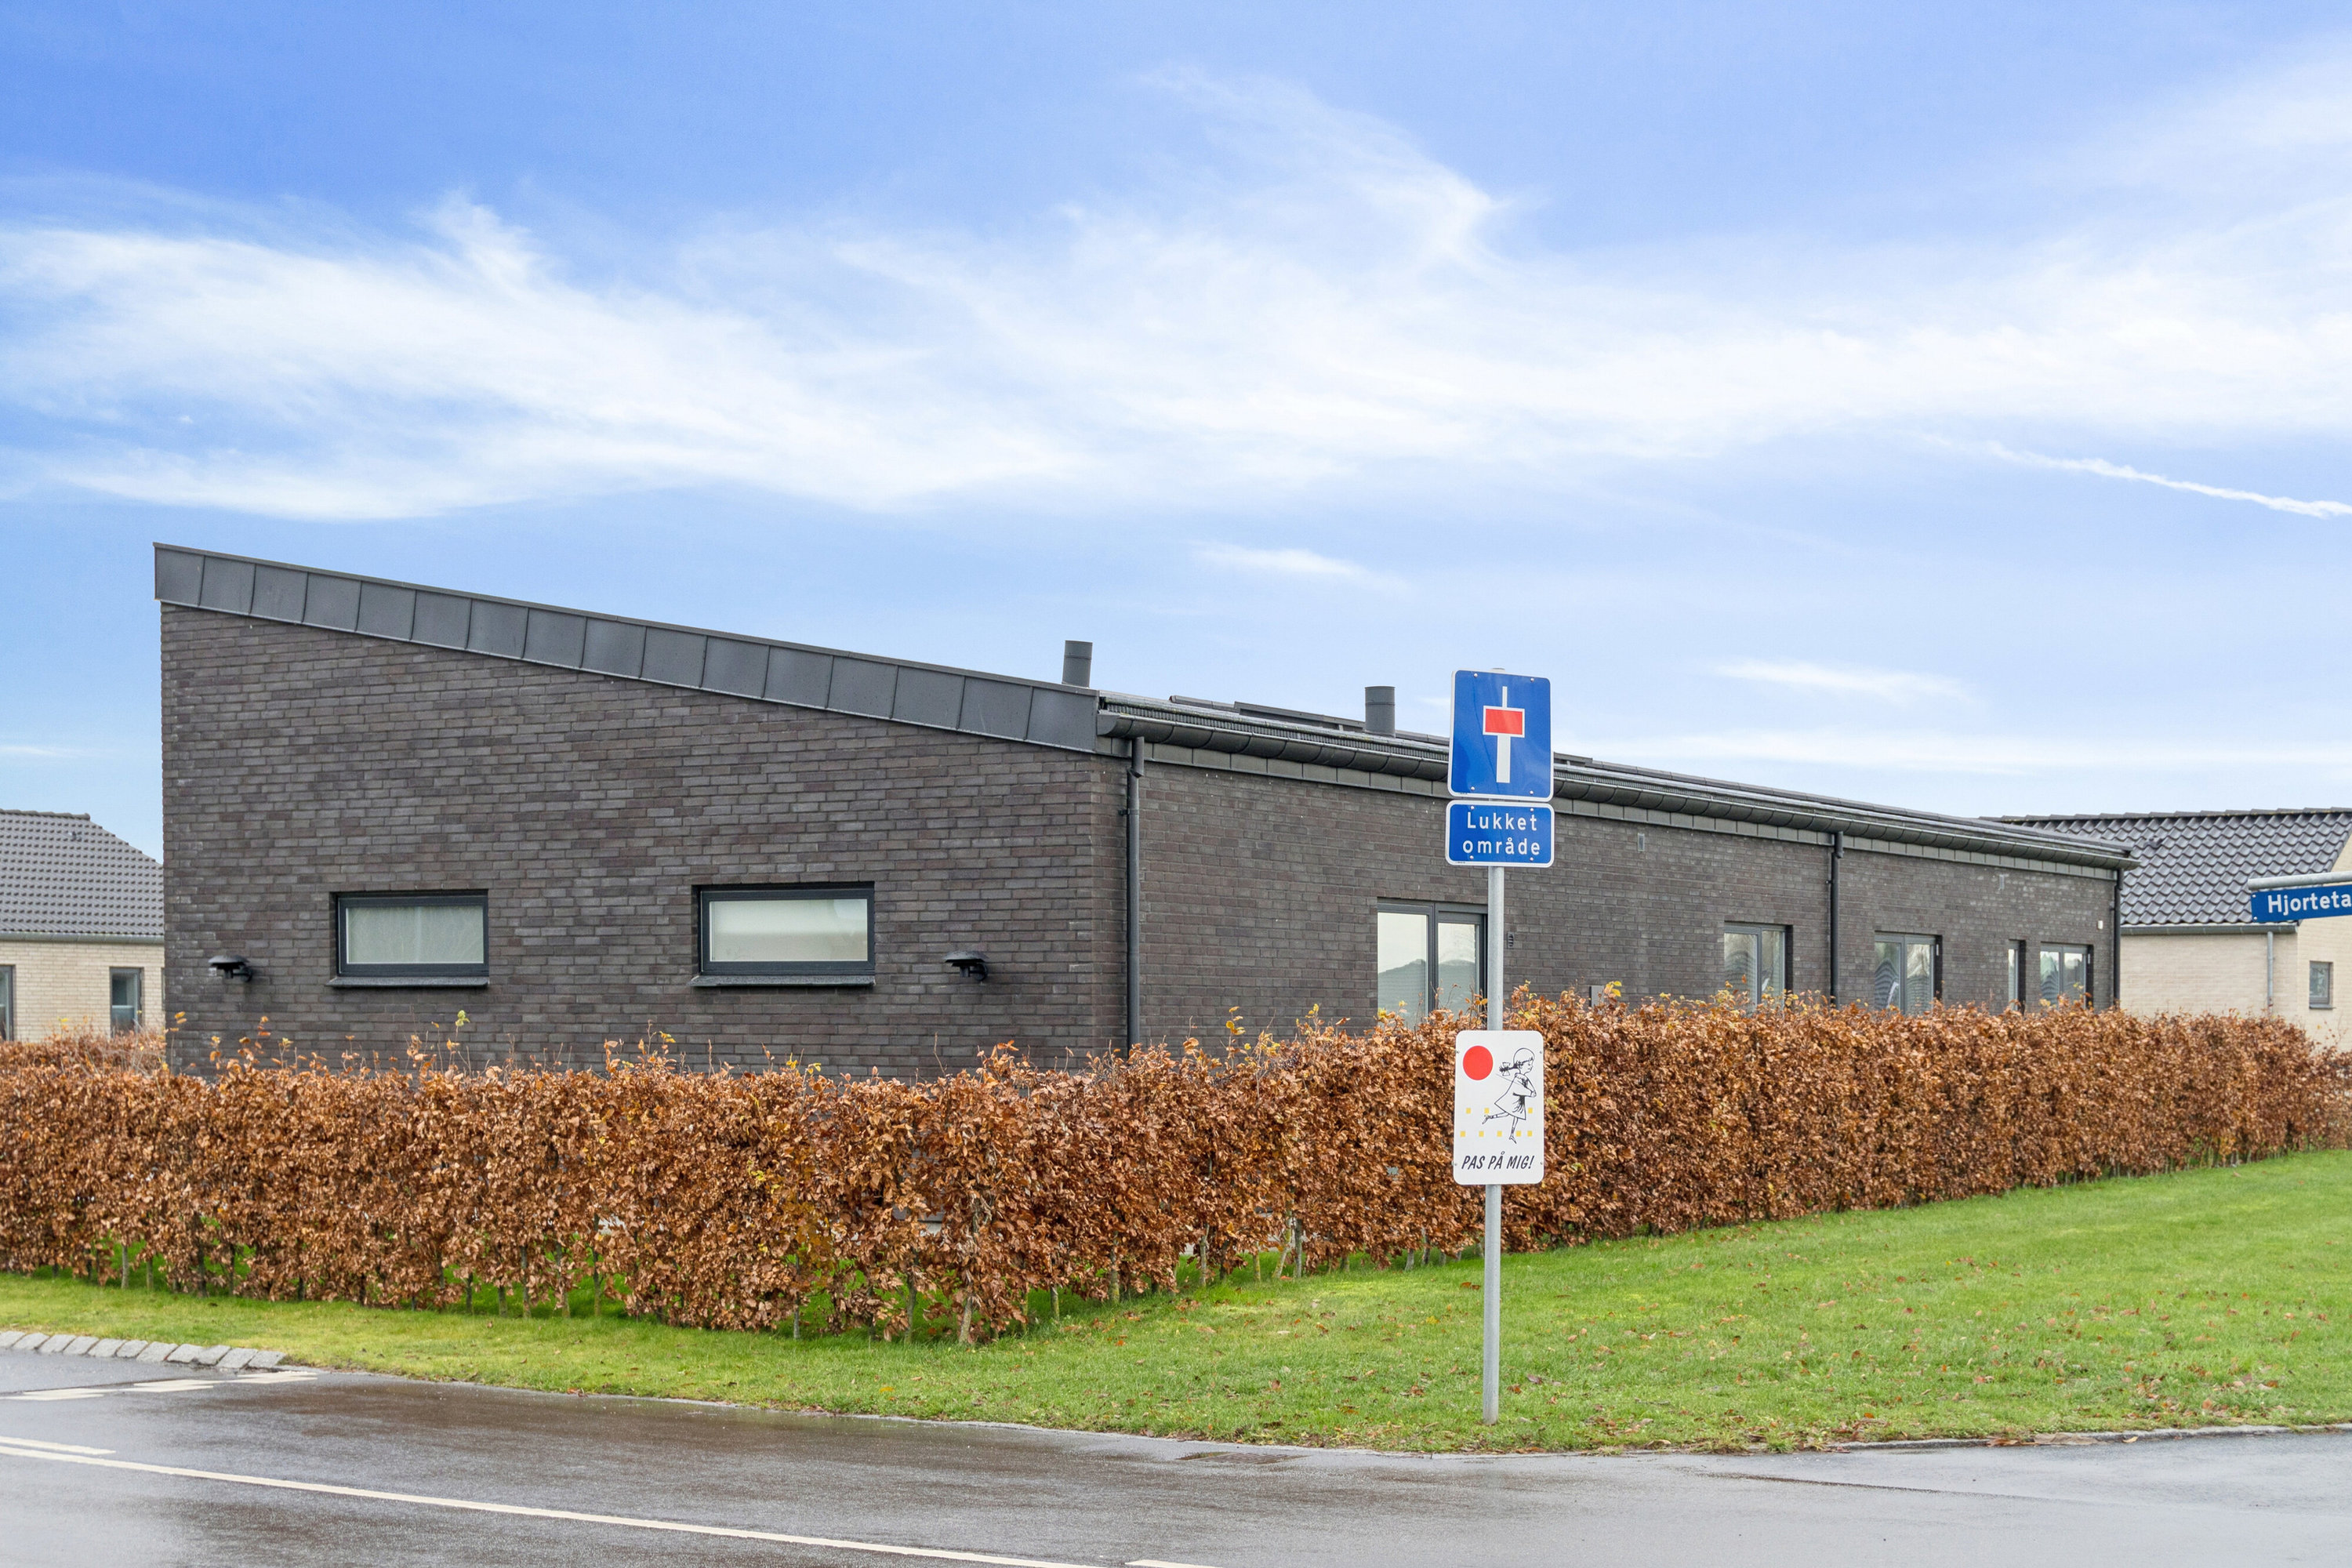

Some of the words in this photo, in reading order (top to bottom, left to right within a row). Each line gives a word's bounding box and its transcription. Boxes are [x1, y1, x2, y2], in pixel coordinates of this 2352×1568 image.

[1467, 811, 1537, 831] Lukket
[1462, 837, 1541, 855] område
[2267, 891, 2352, 916] Hjorteta
[1461, 1155, 1485, 1170] PAS
[1487, 1151, 1505, 1170] PÅ
[1506, 1155, 1535, 1170] MIG!
